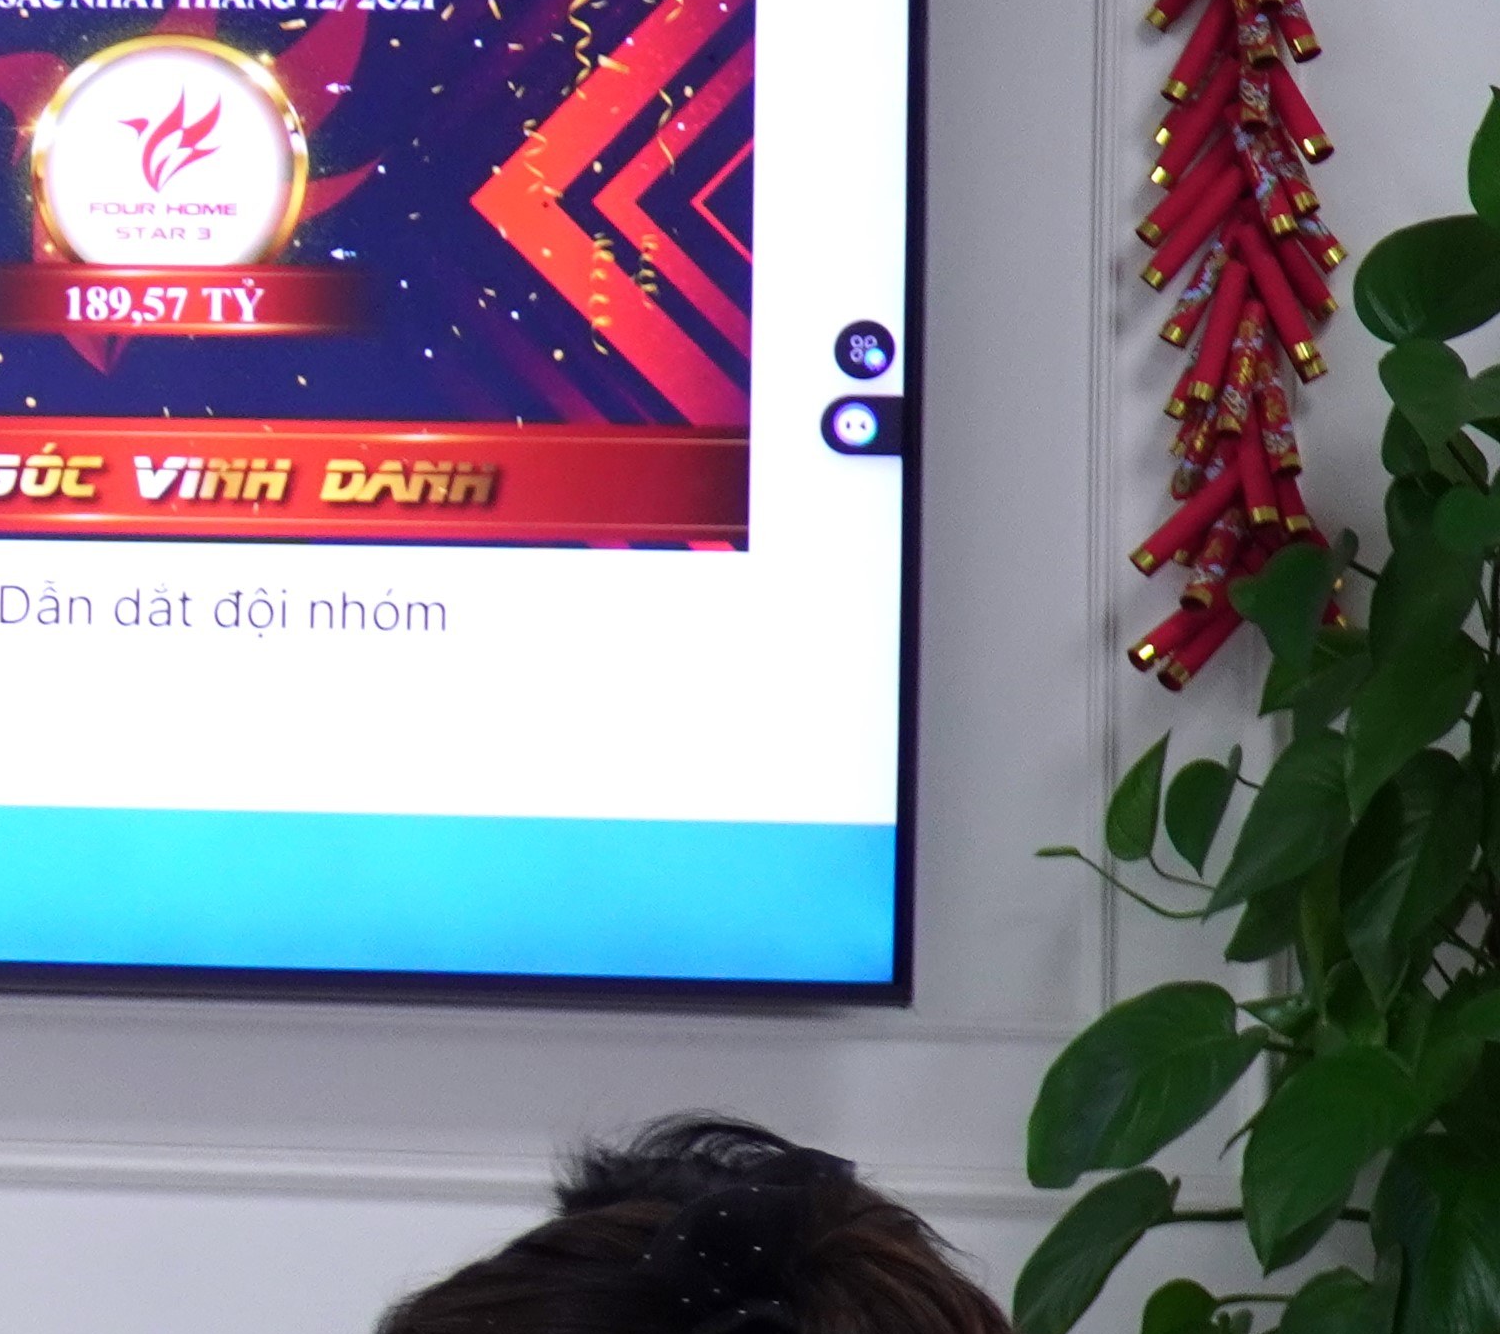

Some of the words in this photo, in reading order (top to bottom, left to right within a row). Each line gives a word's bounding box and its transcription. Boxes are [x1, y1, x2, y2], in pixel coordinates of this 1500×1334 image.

[89, 202, 156, 215] FOUR
[165, 202, 238, 216] HOME
[115, 226, 187, 240] STAR
[196, 226, 212, 240] 3
[65, 286, 189, 326] 189,57
[201, 277, 266, 323] TỶ
[319, 458, 499, 506] DANH
[113, 583, 194, 629] dắt
[213, 586, 289, 640] đội
[308, 588, 449, 632] nhóm
